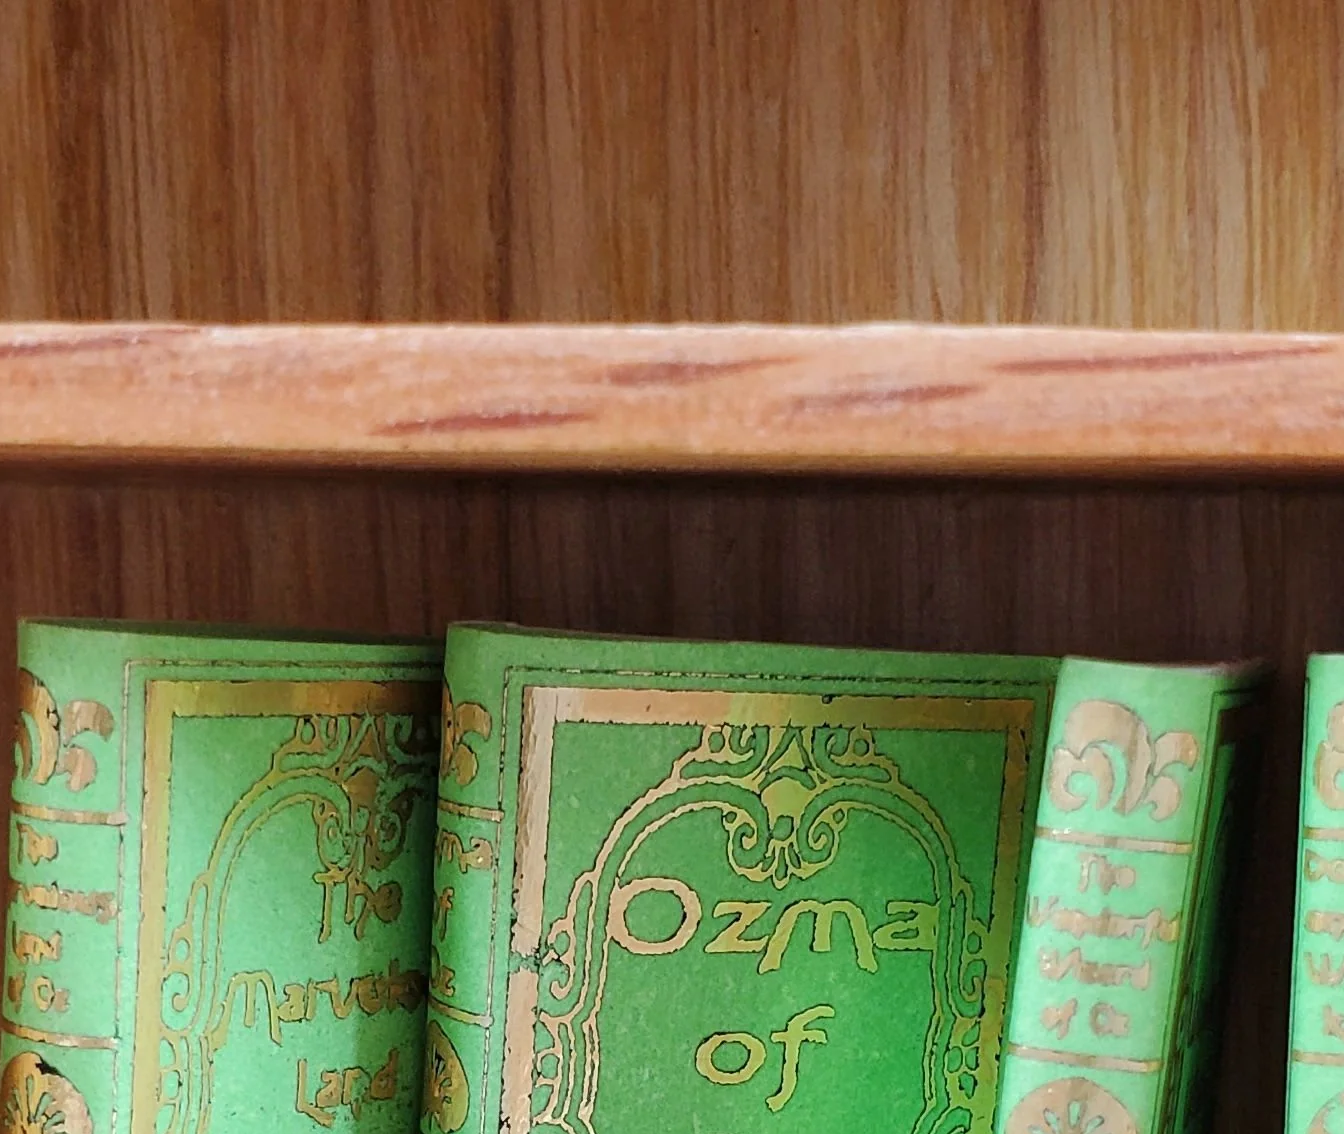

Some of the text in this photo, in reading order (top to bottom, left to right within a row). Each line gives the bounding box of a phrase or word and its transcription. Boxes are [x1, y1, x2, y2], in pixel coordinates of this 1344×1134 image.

[312, 868, 402, 943] The
[608, 877, 940, 974] Ozma
[295, 1047, 400, 1128] Land
[694, 1004, 835, 1112] of
